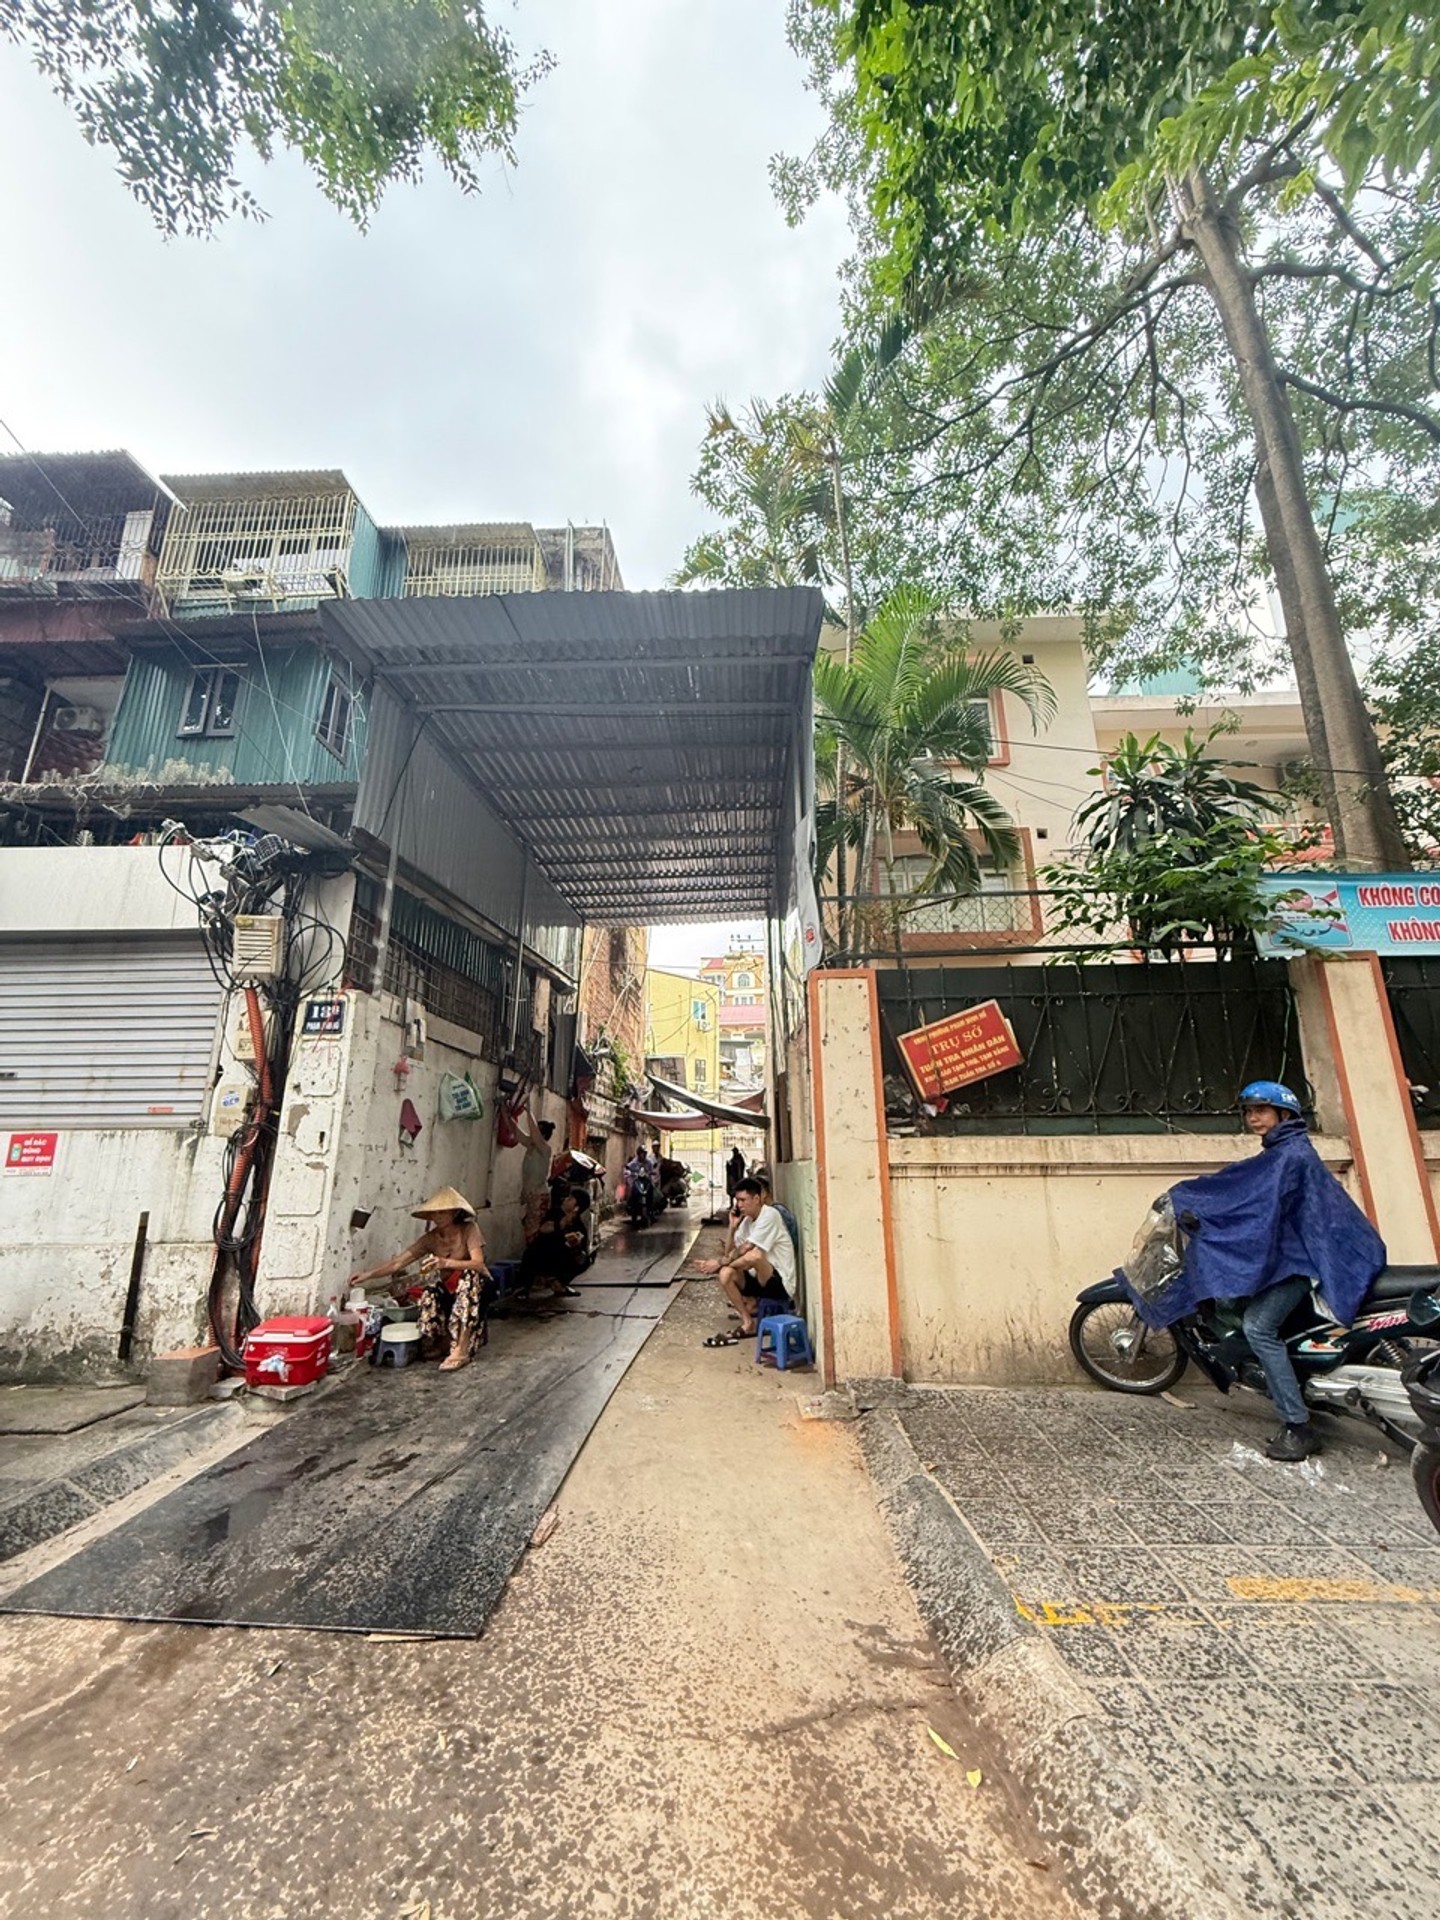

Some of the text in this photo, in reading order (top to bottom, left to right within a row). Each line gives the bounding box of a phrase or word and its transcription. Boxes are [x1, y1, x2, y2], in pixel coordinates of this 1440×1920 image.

[1359, 884, 1415, 905] KHÔNG
[931, 1024, 982, 1055] TRỤ SỞ
